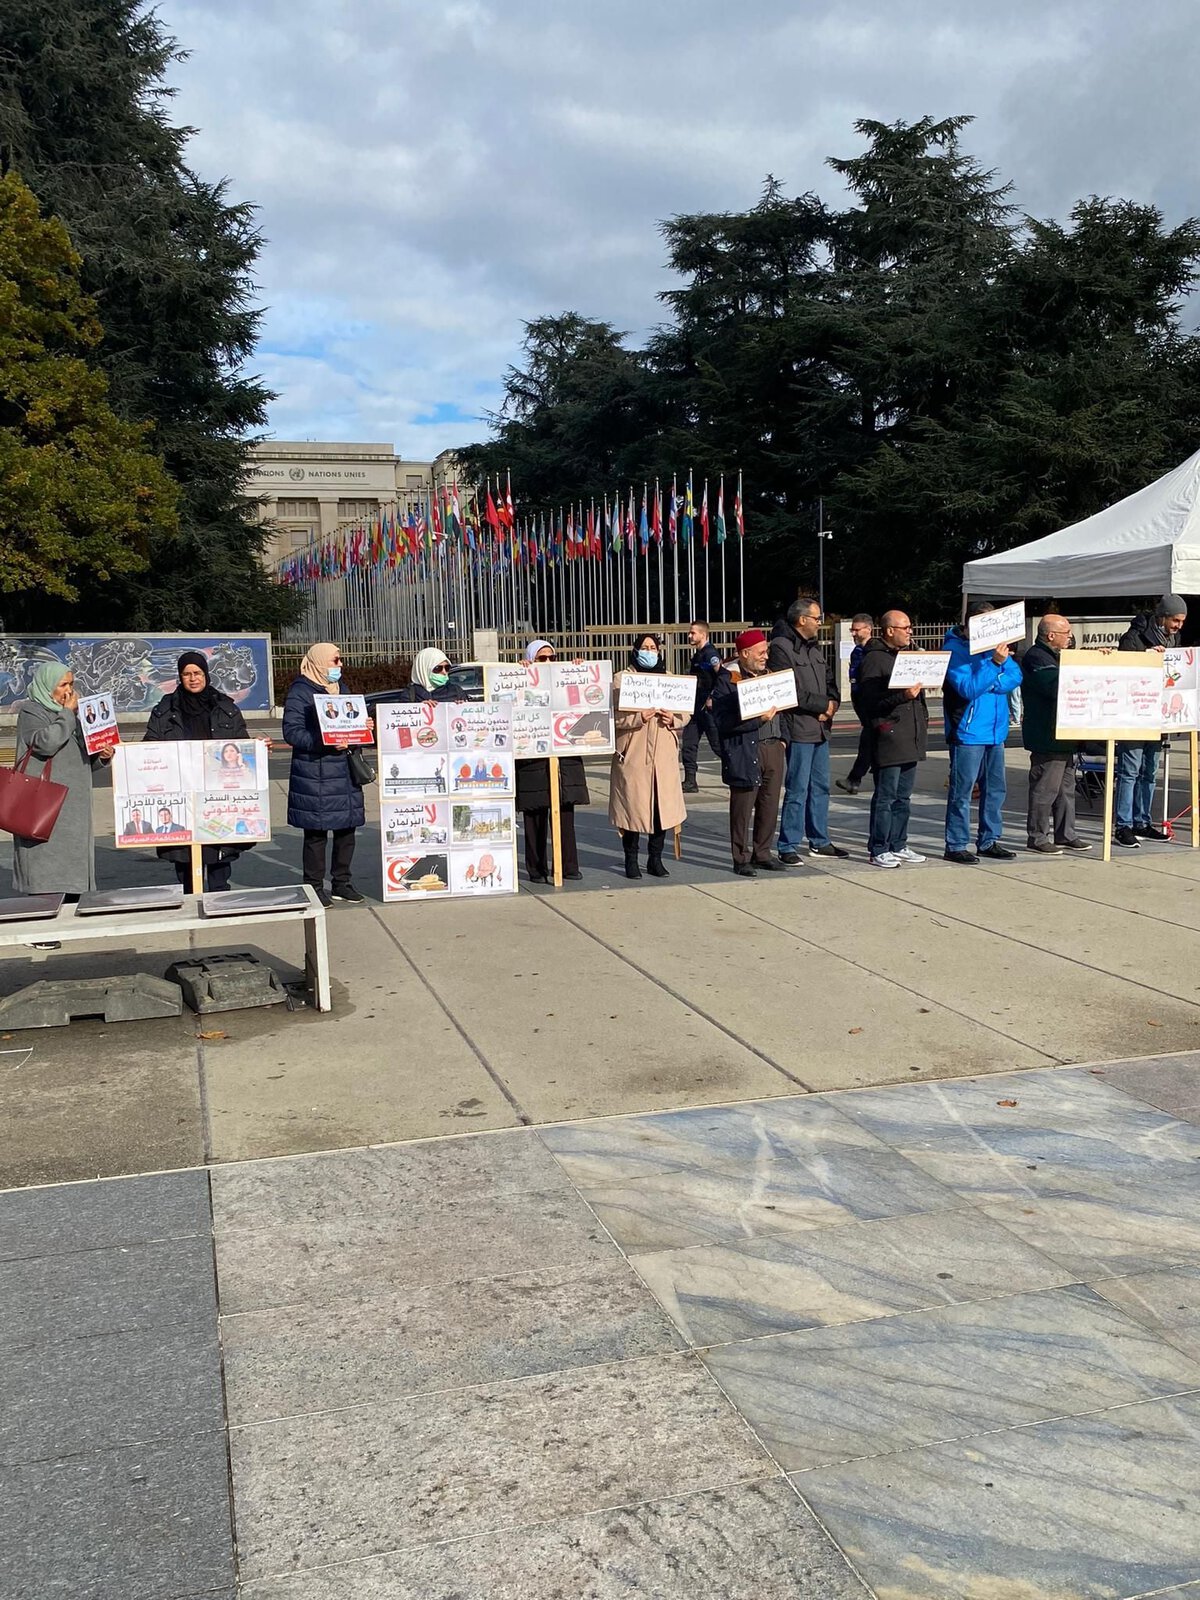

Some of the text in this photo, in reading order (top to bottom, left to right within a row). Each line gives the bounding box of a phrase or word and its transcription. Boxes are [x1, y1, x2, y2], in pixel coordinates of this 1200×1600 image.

[1082, 632, 1122, 643] NATION
[1185, 649, 1193, 665] لا
[499, 667, 539, 688] لا لتجميد
[560, 664, 600, 683] لا لتجميد
[494, 681, 527, 691] البرلمان
[625, 676, 653, 687] Droits
[390, 707, 421, 718] لتجميد
[422, 706, 434, 725] لا
[488, 706, 499, 715] كل
[528, 712, 540, 722] كل
[124, 797, 187, 809] الحرية للأحرار
[204, 793, 259, 804] تحجير السفر
[203, 804, 261, 819] غير قانوني
[394, 804, 437, 826] لا لتجميد
[389, 818, 424, 828] البرلمان
